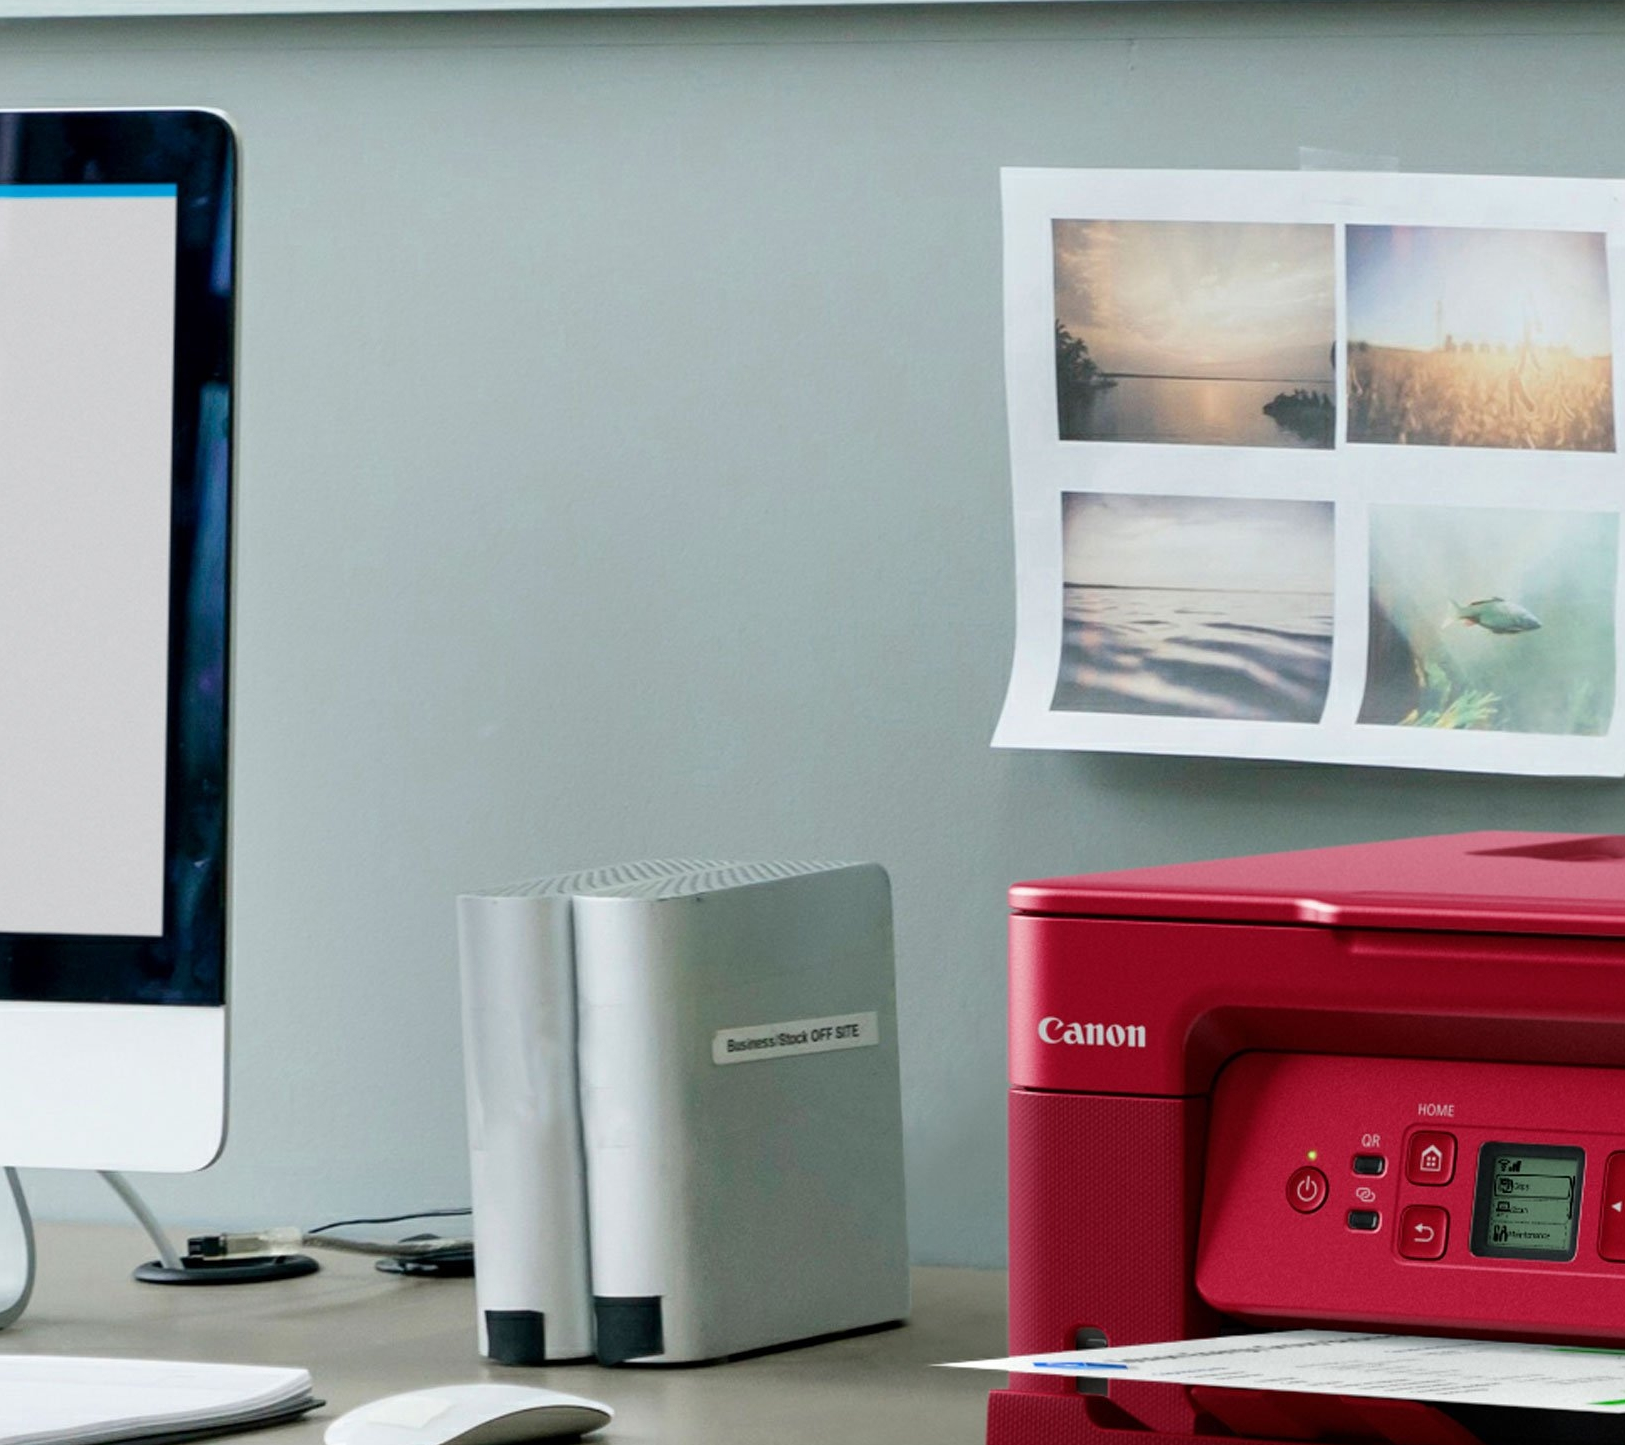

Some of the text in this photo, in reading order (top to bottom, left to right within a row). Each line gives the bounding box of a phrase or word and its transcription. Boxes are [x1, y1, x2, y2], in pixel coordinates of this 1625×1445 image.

[810, 1027, 833, 1043] OFF
[835, 1023, 860, 1039] SITE
[1038, 1016, 1147, 1048] Canon
[1417, 1103, 1455, 1117] HOME
[1361, 1133, 1381, 1148] QR
